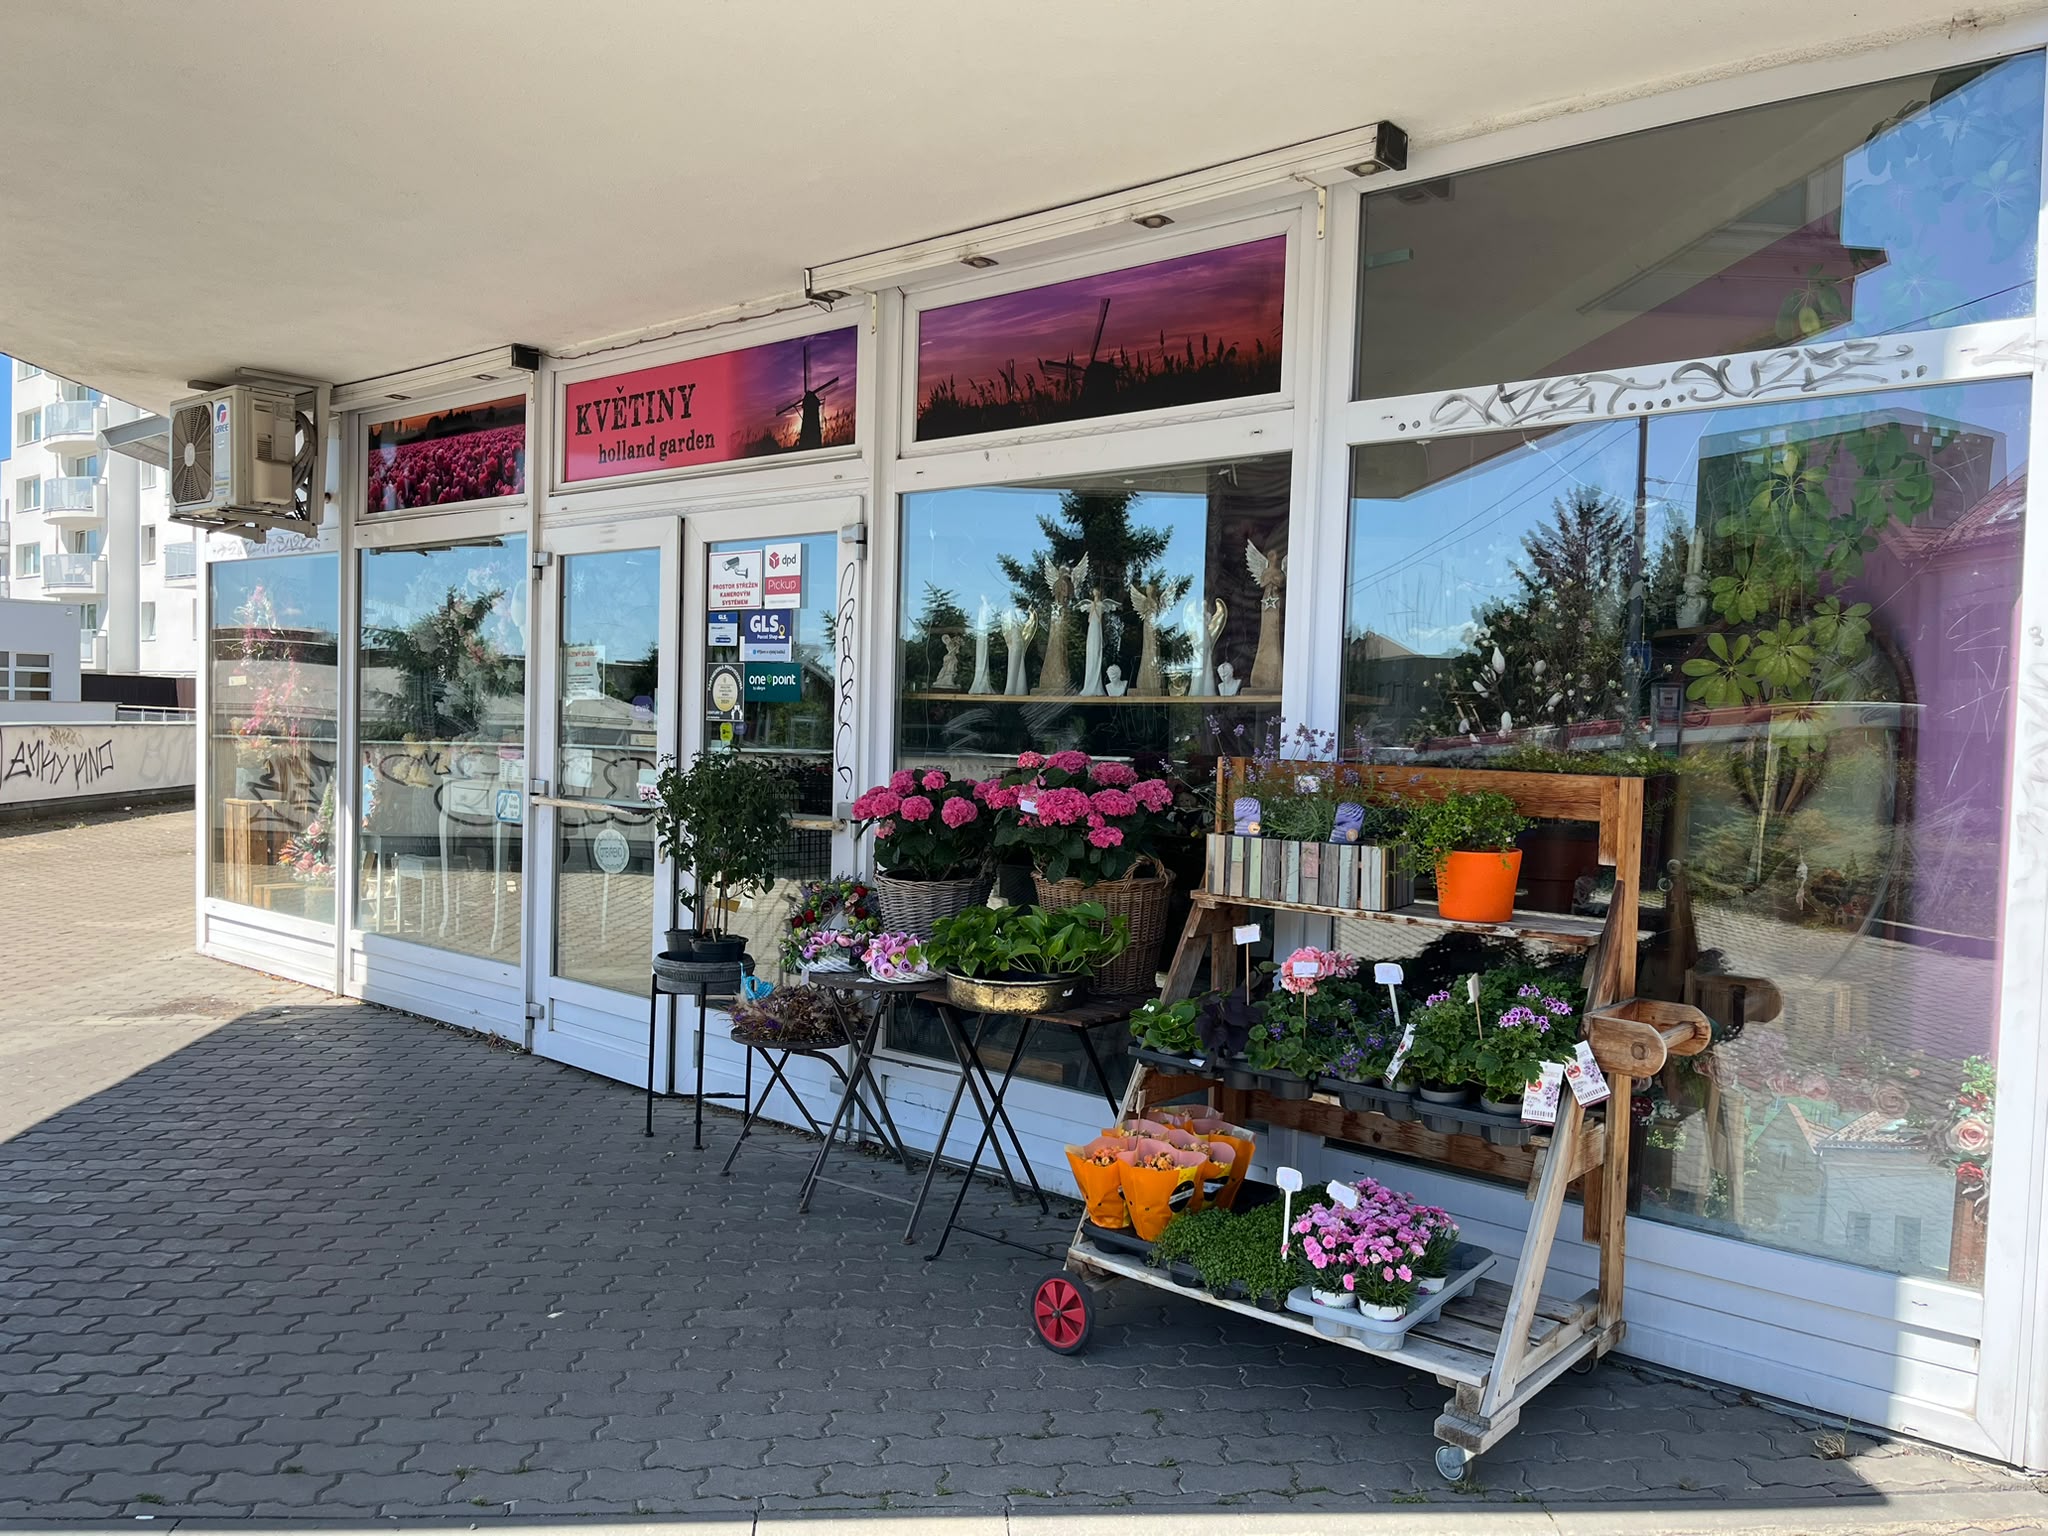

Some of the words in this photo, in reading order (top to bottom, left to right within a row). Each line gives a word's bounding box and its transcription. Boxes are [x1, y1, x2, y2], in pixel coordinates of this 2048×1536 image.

[575, 383, 696, 436] KVĚTINY
[214, 423, 229, 434] GREE
[598, 435, 655, 464] holland
[659, 429, 715, 461] garden
[782, 554, 796, 566] dpd
[768, 580, 797, 590] Pickup
[750, 614, 779, 632] GLS
[749, 675, 766, 684] one
[772, 674, 796, 686] point
